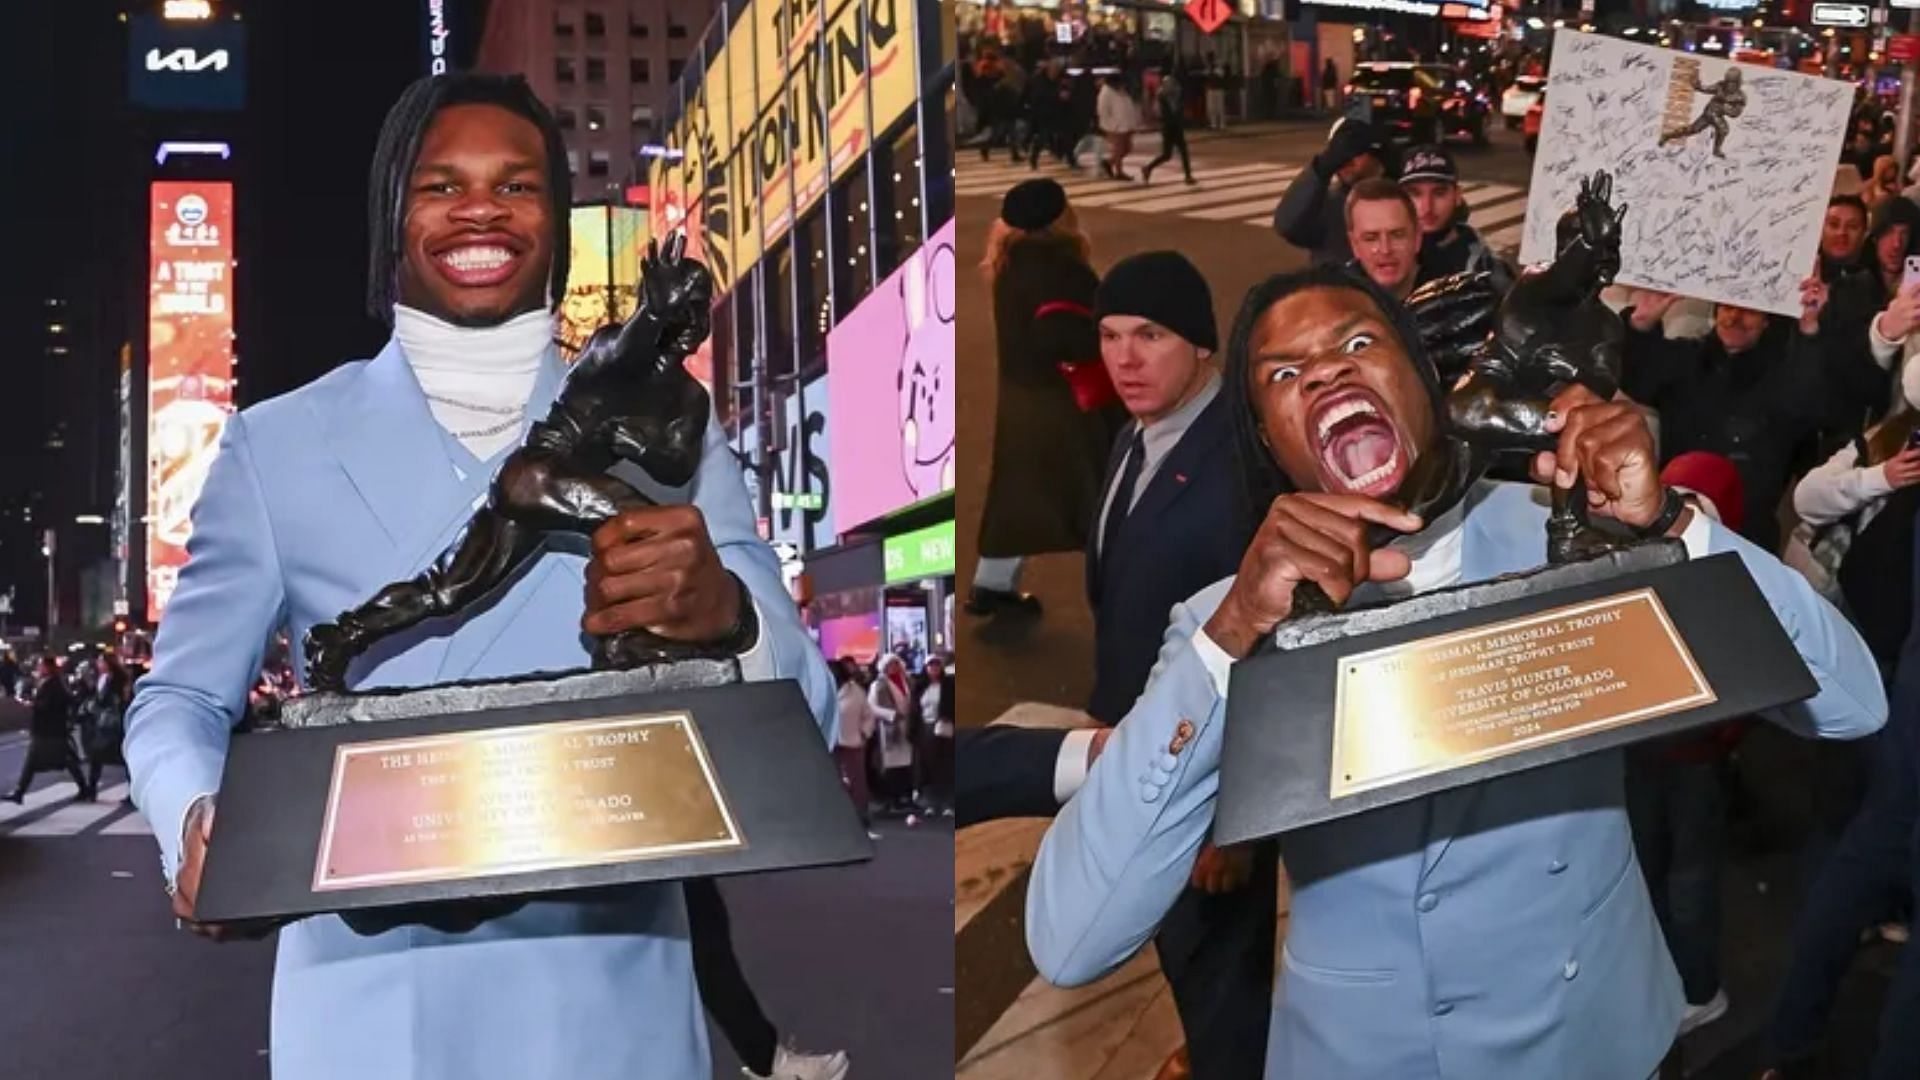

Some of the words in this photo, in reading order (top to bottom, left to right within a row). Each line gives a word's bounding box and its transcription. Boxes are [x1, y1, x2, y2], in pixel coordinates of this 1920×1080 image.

[738, 86, 801, 237] LION
[1484, 622, 1565, 651] MEMORIAL
[1565, 609, 1623, 632] TROPHY
[1506, 644, 1556, 665] TROPHY
[1455, 679, 1509, 702] TRAVIS
[1510, 664, 1574, 689] HUNTER
[1511, 687, 1532, 702] OF
[1534, 667, 1616, 696] COLORADO
[379, 752, 412, 769] THE
[587, 729, 650, 749] TROPHY
